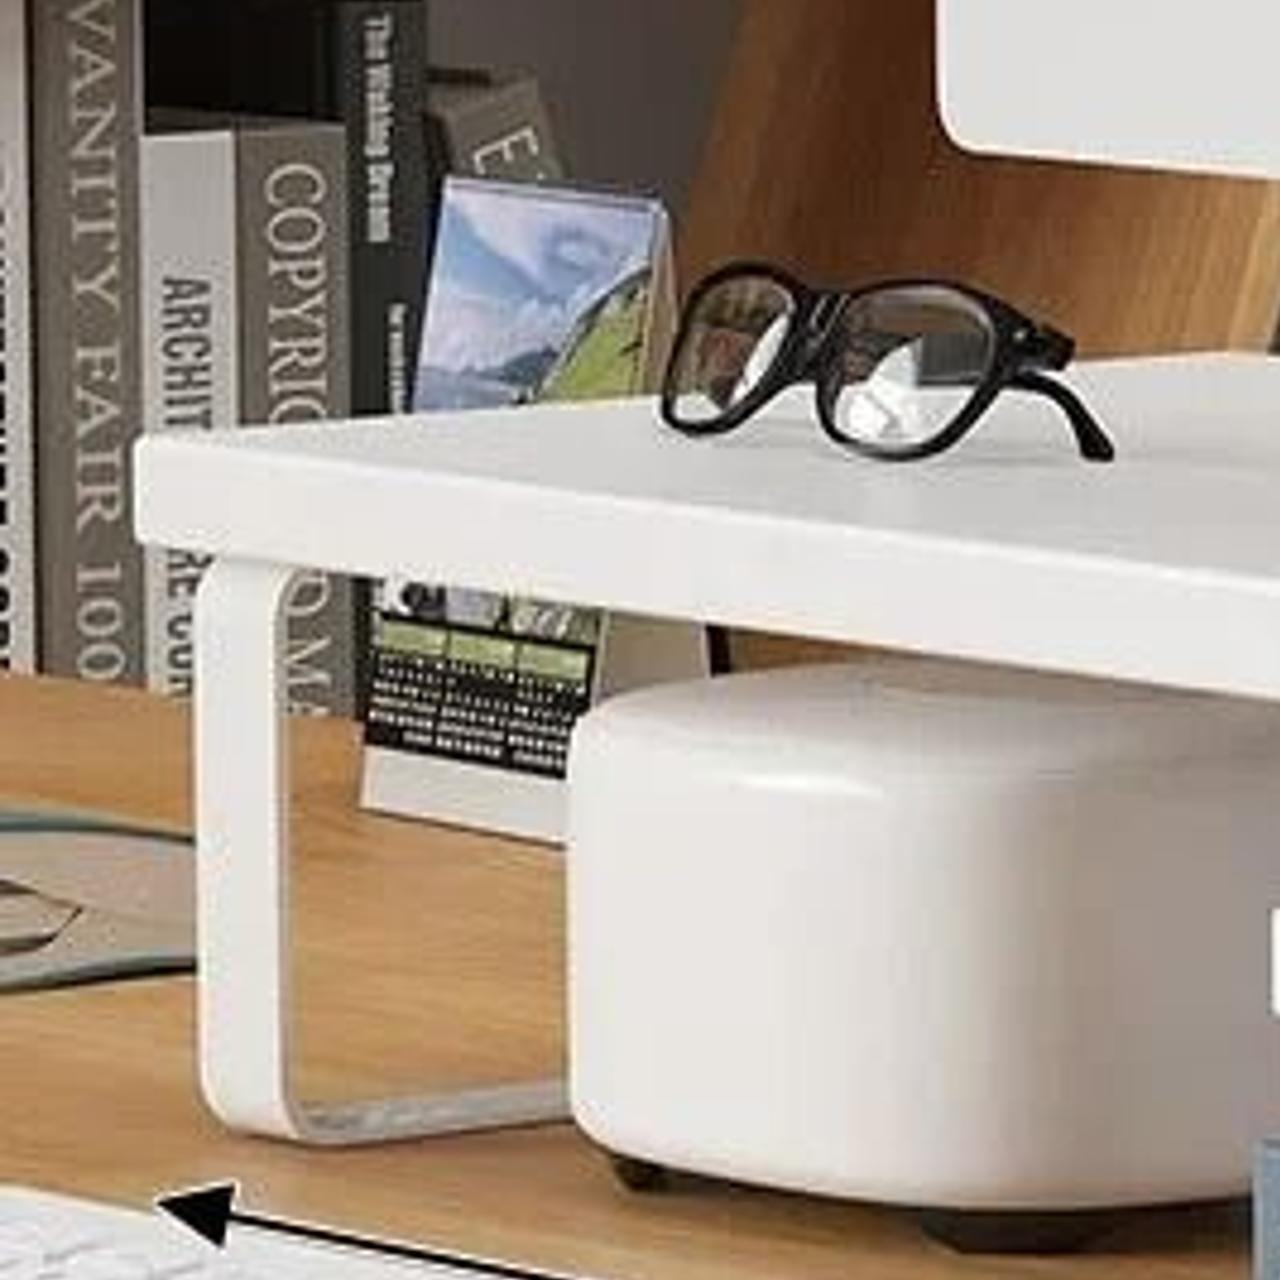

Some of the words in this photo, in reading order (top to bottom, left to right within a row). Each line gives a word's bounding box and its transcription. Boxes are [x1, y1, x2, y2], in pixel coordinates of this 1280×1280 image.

[363, 13, 391, 58] The
[363, 66, 391, 156] Waking
[363, 164, 391, 242] Dream
[75, 346, 121, 533] FAIR
[78, 563, 125, 680] 100
